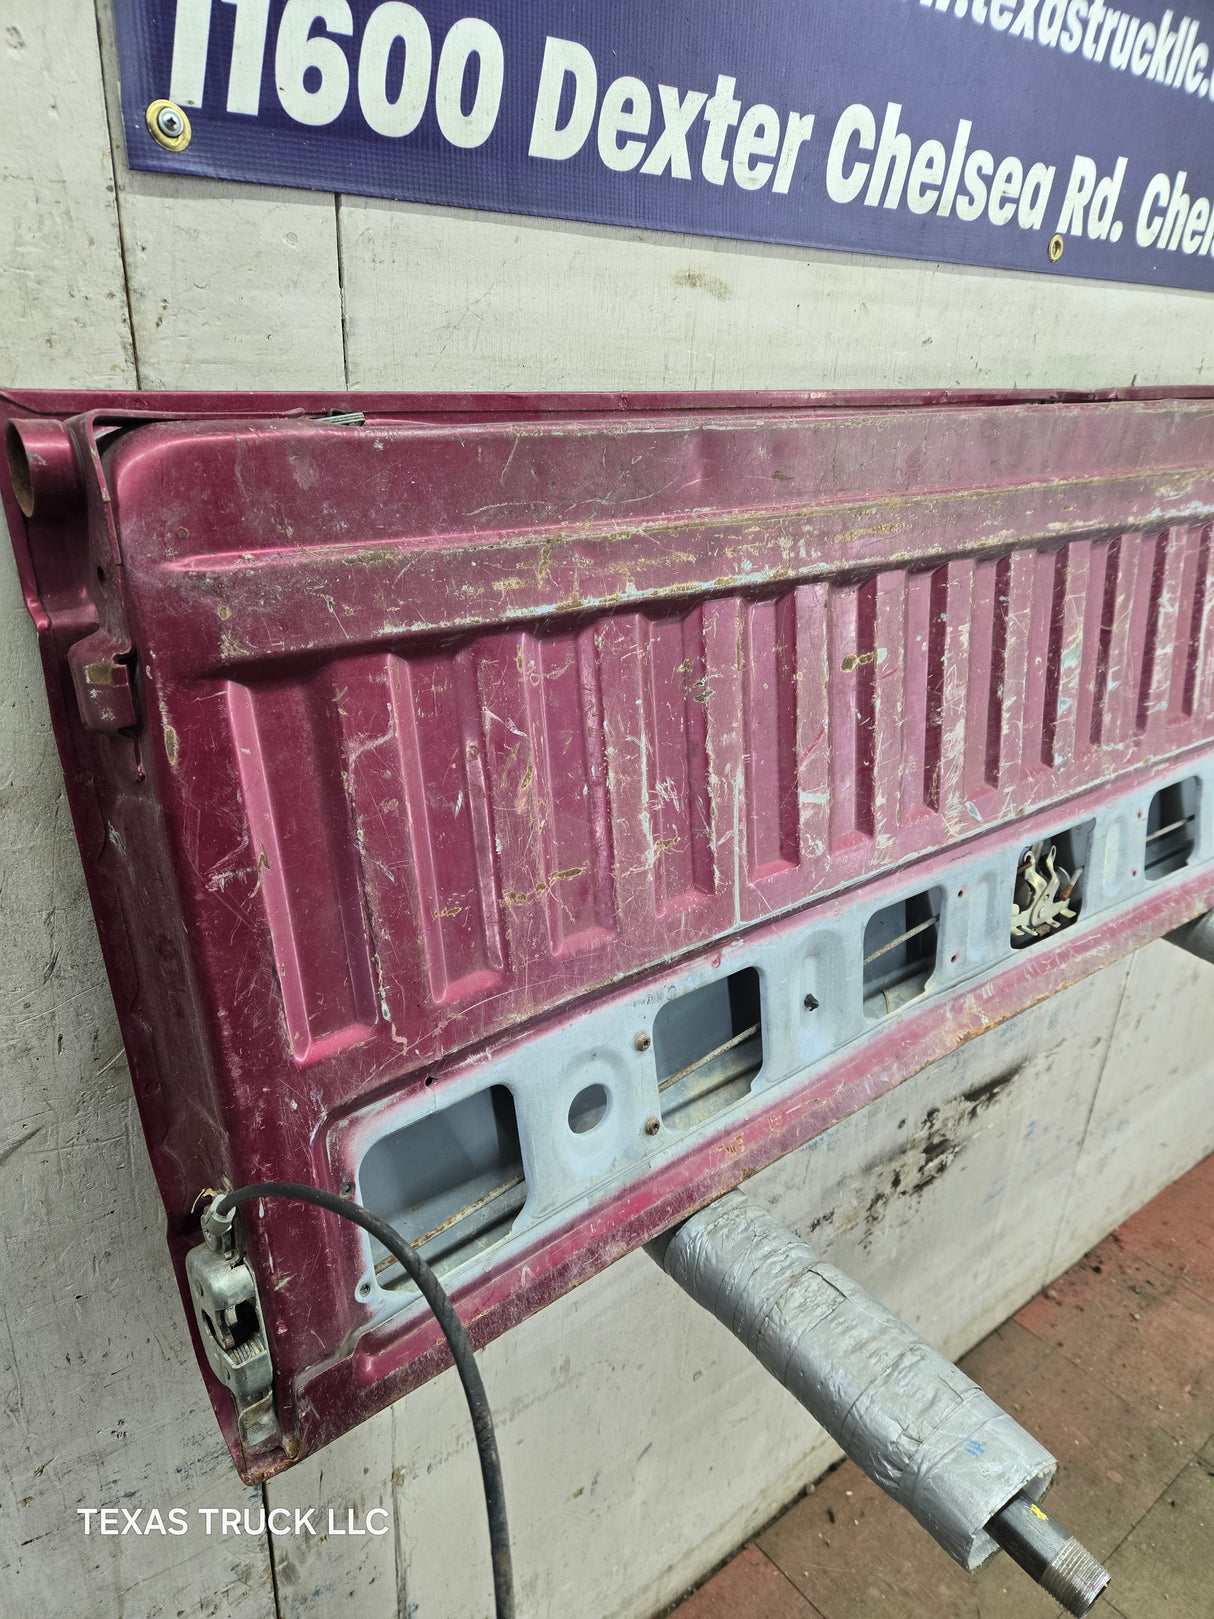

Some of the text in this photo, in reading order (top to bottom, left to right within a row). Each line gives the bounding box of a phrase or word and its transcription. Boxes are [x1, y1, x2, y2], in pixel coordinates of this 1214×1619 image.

[168, 0, 1214, 258] 11600 Dexter Chelsea Rd. Chel
